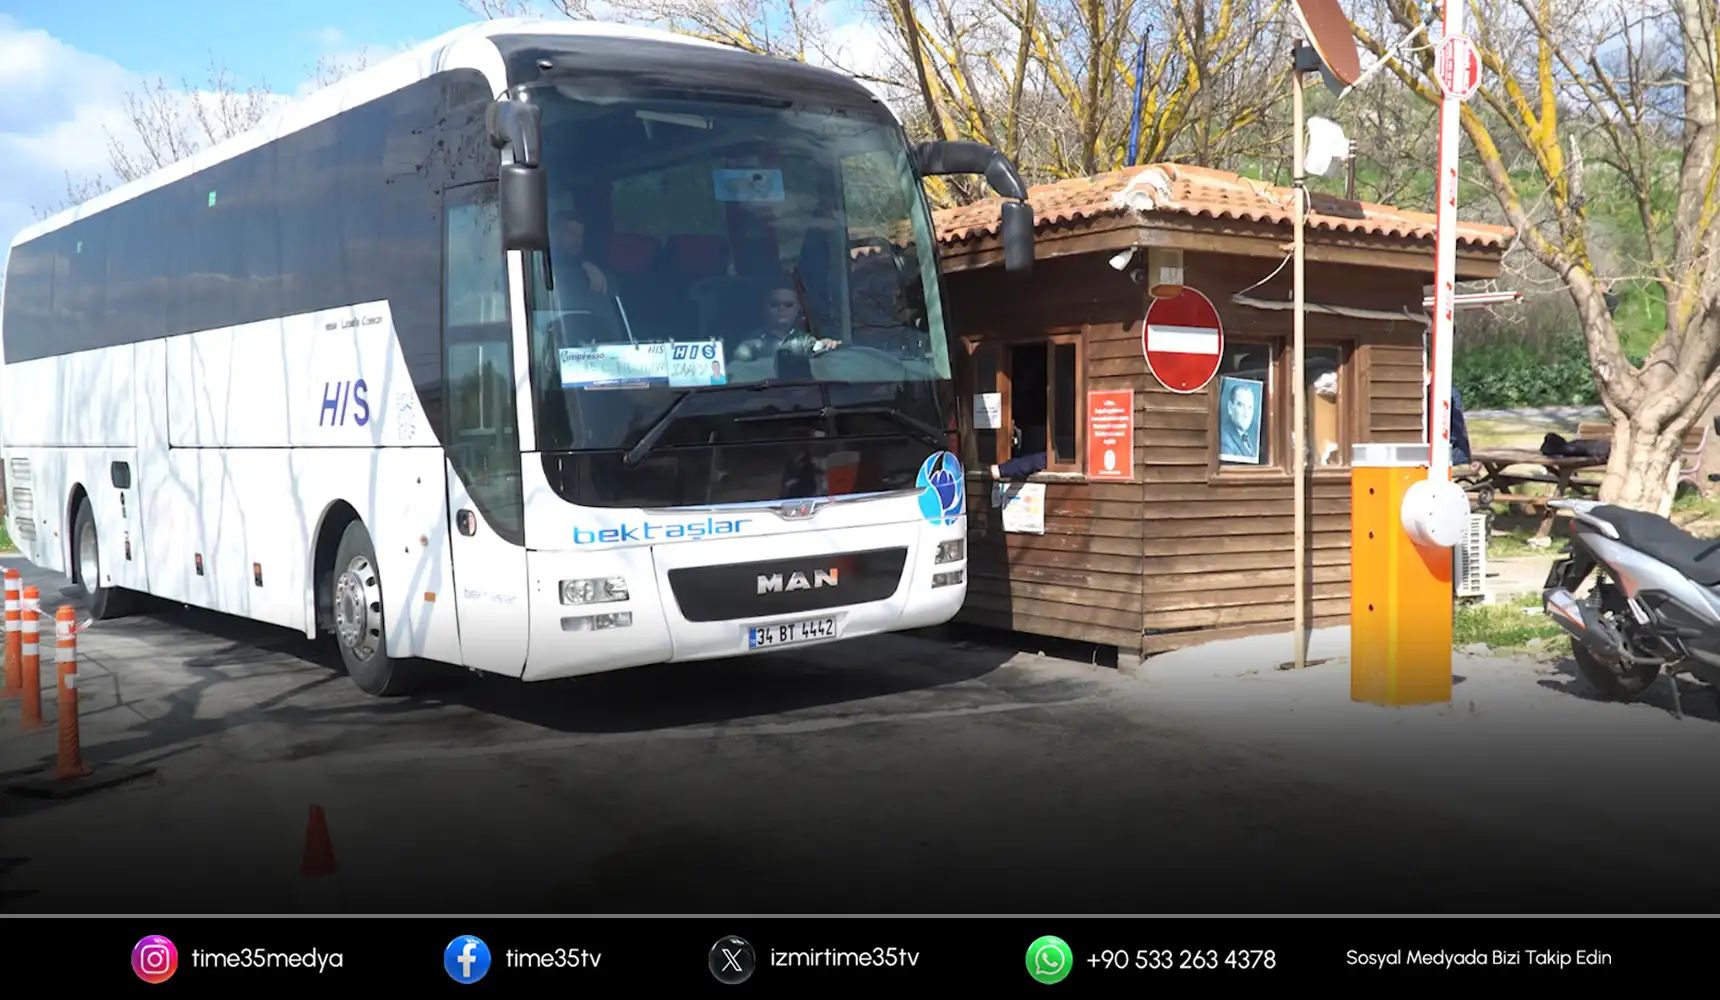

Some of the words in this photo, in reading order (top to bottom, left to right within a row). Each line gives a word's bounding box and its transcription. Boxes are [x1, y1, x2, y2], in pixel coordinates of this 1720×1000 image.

[672, 344, 716, 360] HIS
[319, 378, 370, 427] HIS
[573, 517, 753, 545] bektaşlar
[757, 568, 839, 595] MAN
[757, 628, 773, 646] 34
[779, 624, 796, 642] BT
[801, 618, 834, 639] 4442
